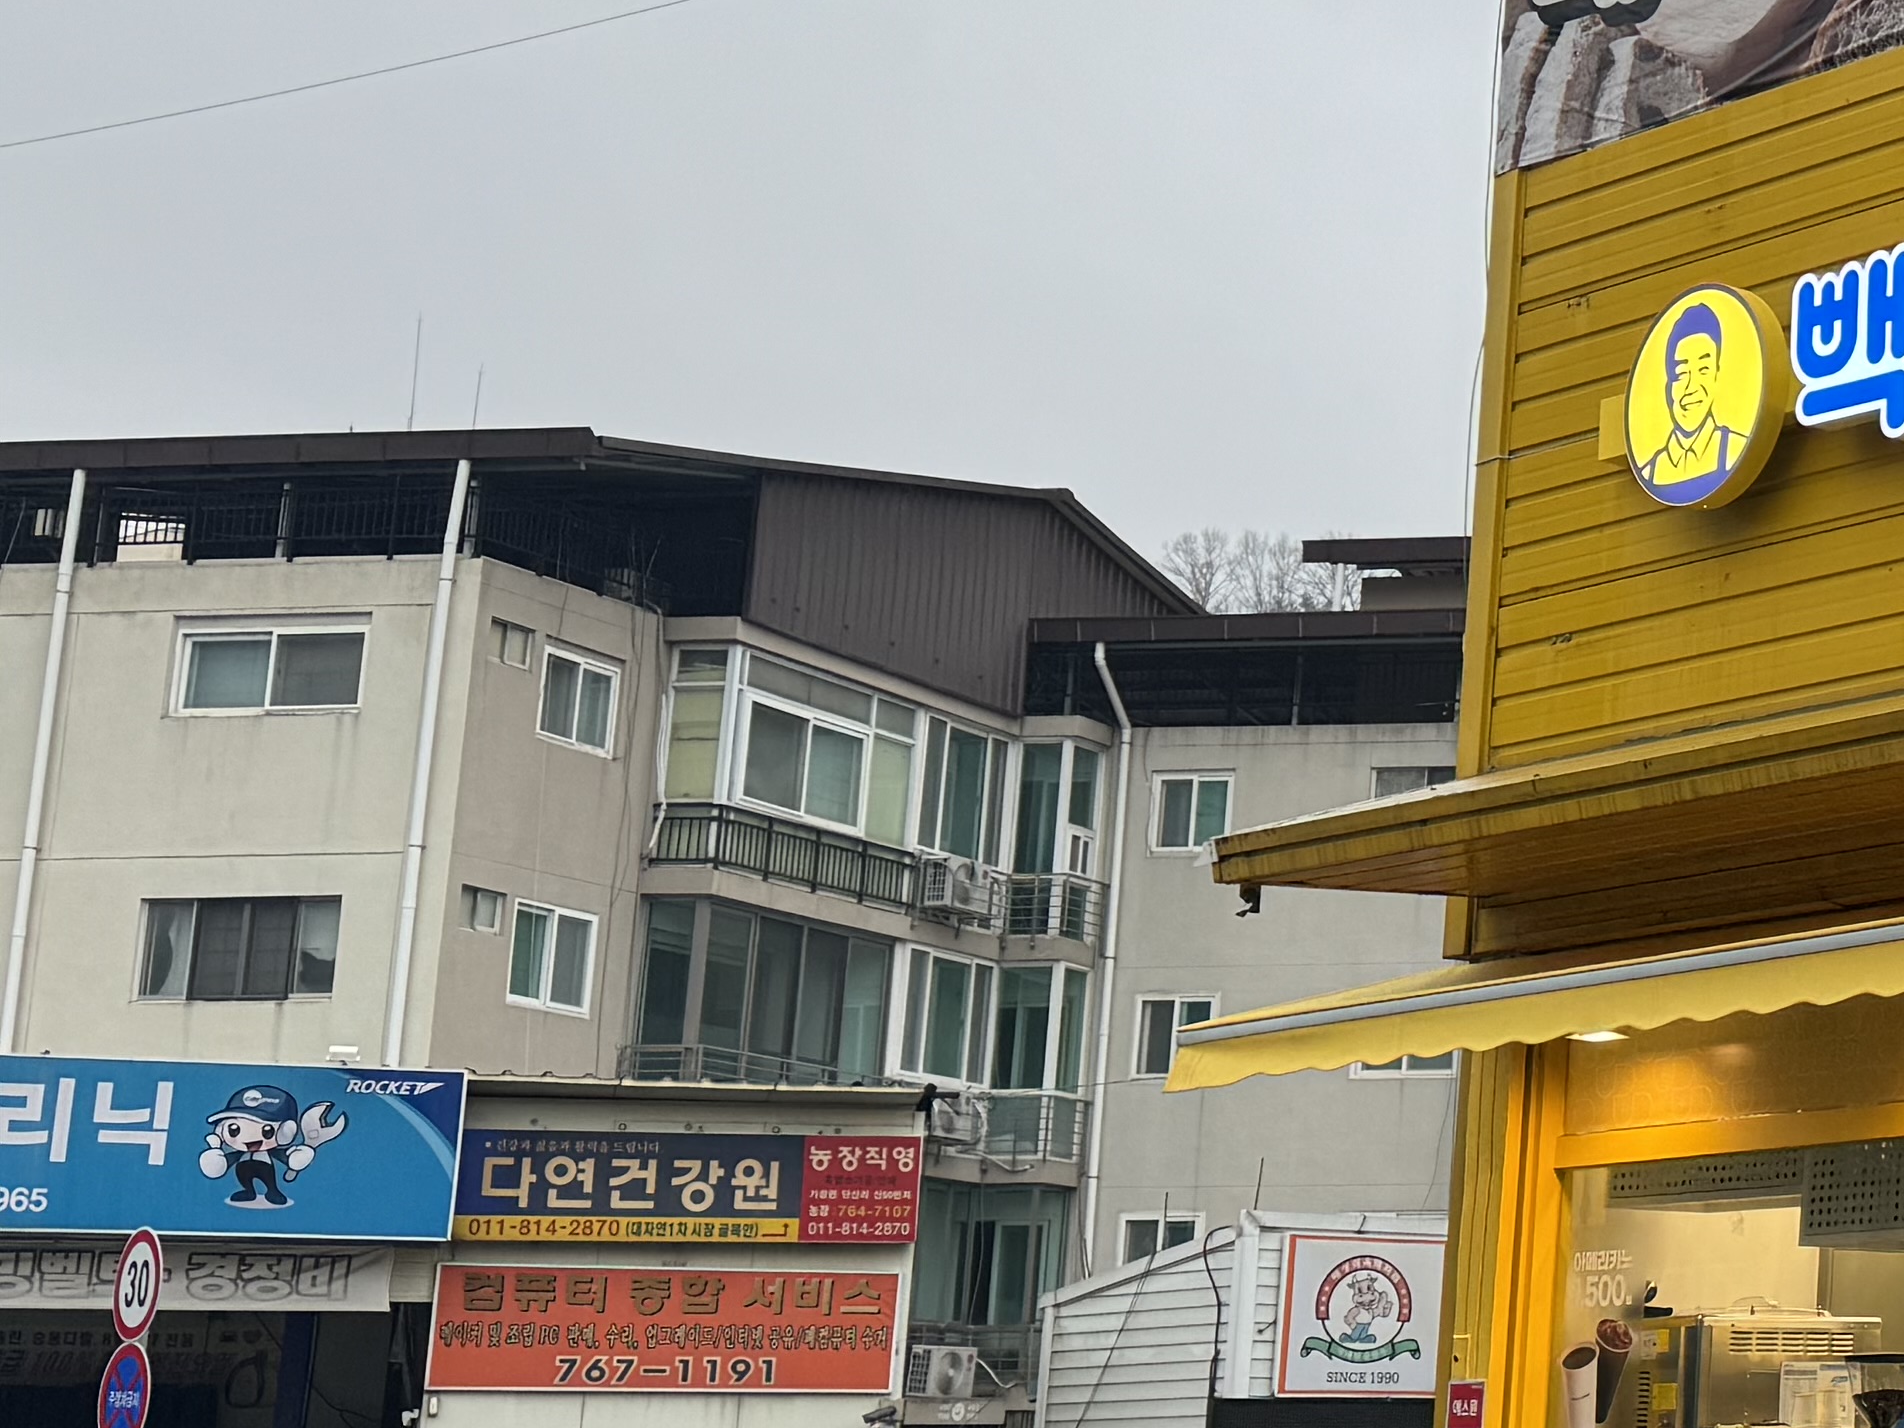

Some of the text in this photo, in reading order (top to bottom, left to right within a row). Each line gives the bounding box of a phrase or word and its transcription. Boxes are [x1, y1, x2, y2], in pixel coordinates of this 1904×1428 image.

[346, 1079, 444, 1096] ROCKET
[809, 1145, 915, 1173] 농장직영
[481, 1156, 780, 1212] 다연건강원
[838, 1205, 911, 1217] 764-7107
[468, 1219, 620, 1236] 011-814-2870
[808, 1222, 910, 1235] 011-814-2870
[1574, 1249, 1633, 1272] 아메리카노
[124, 1259, 150, 1308] 30
[186, 1252, 350, 1301] 경정비
[464, 1272, 881, 1316] 컴퓨터 종합 서비스
[488, 1321, 502, 1348] 및
[505, 1322, 535, 1348] 조립
[539, 1324, 560, 1345] PC
[553, 1355, 777, 1385] 767-1191
[1326, 1372, 1399, 1384] SINCE 1990
